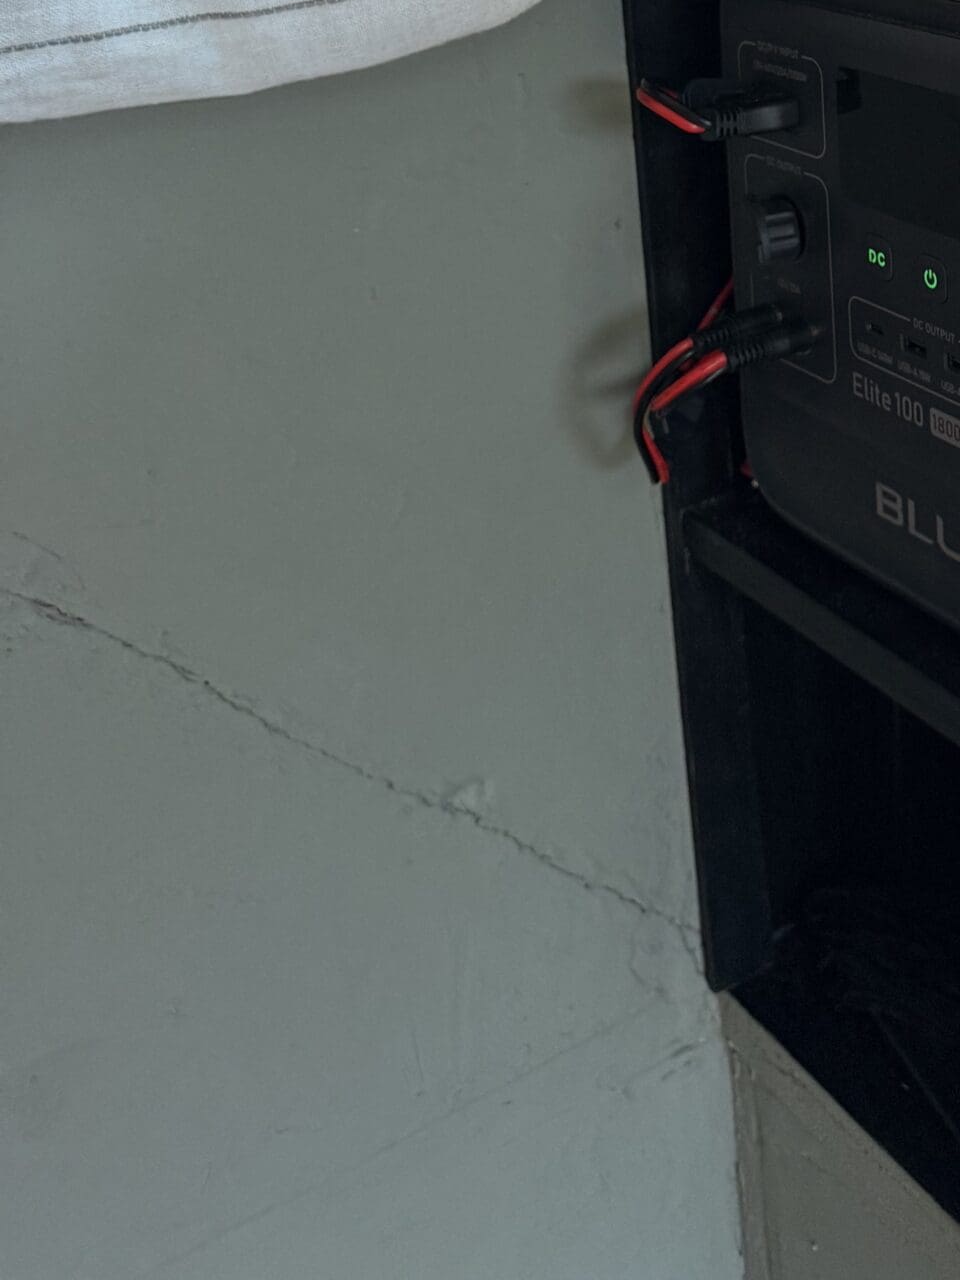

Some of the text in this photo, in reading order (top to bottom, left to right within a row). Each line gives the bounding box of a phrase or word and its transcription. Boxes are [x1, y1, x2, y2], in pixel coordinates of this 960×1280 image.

[867, 247, 887, 268] DC
[912, 317, 956, 345] DC OUTPUT
[852, 371, 892, 412] Elite
[894, 391, 924, 427] 100
